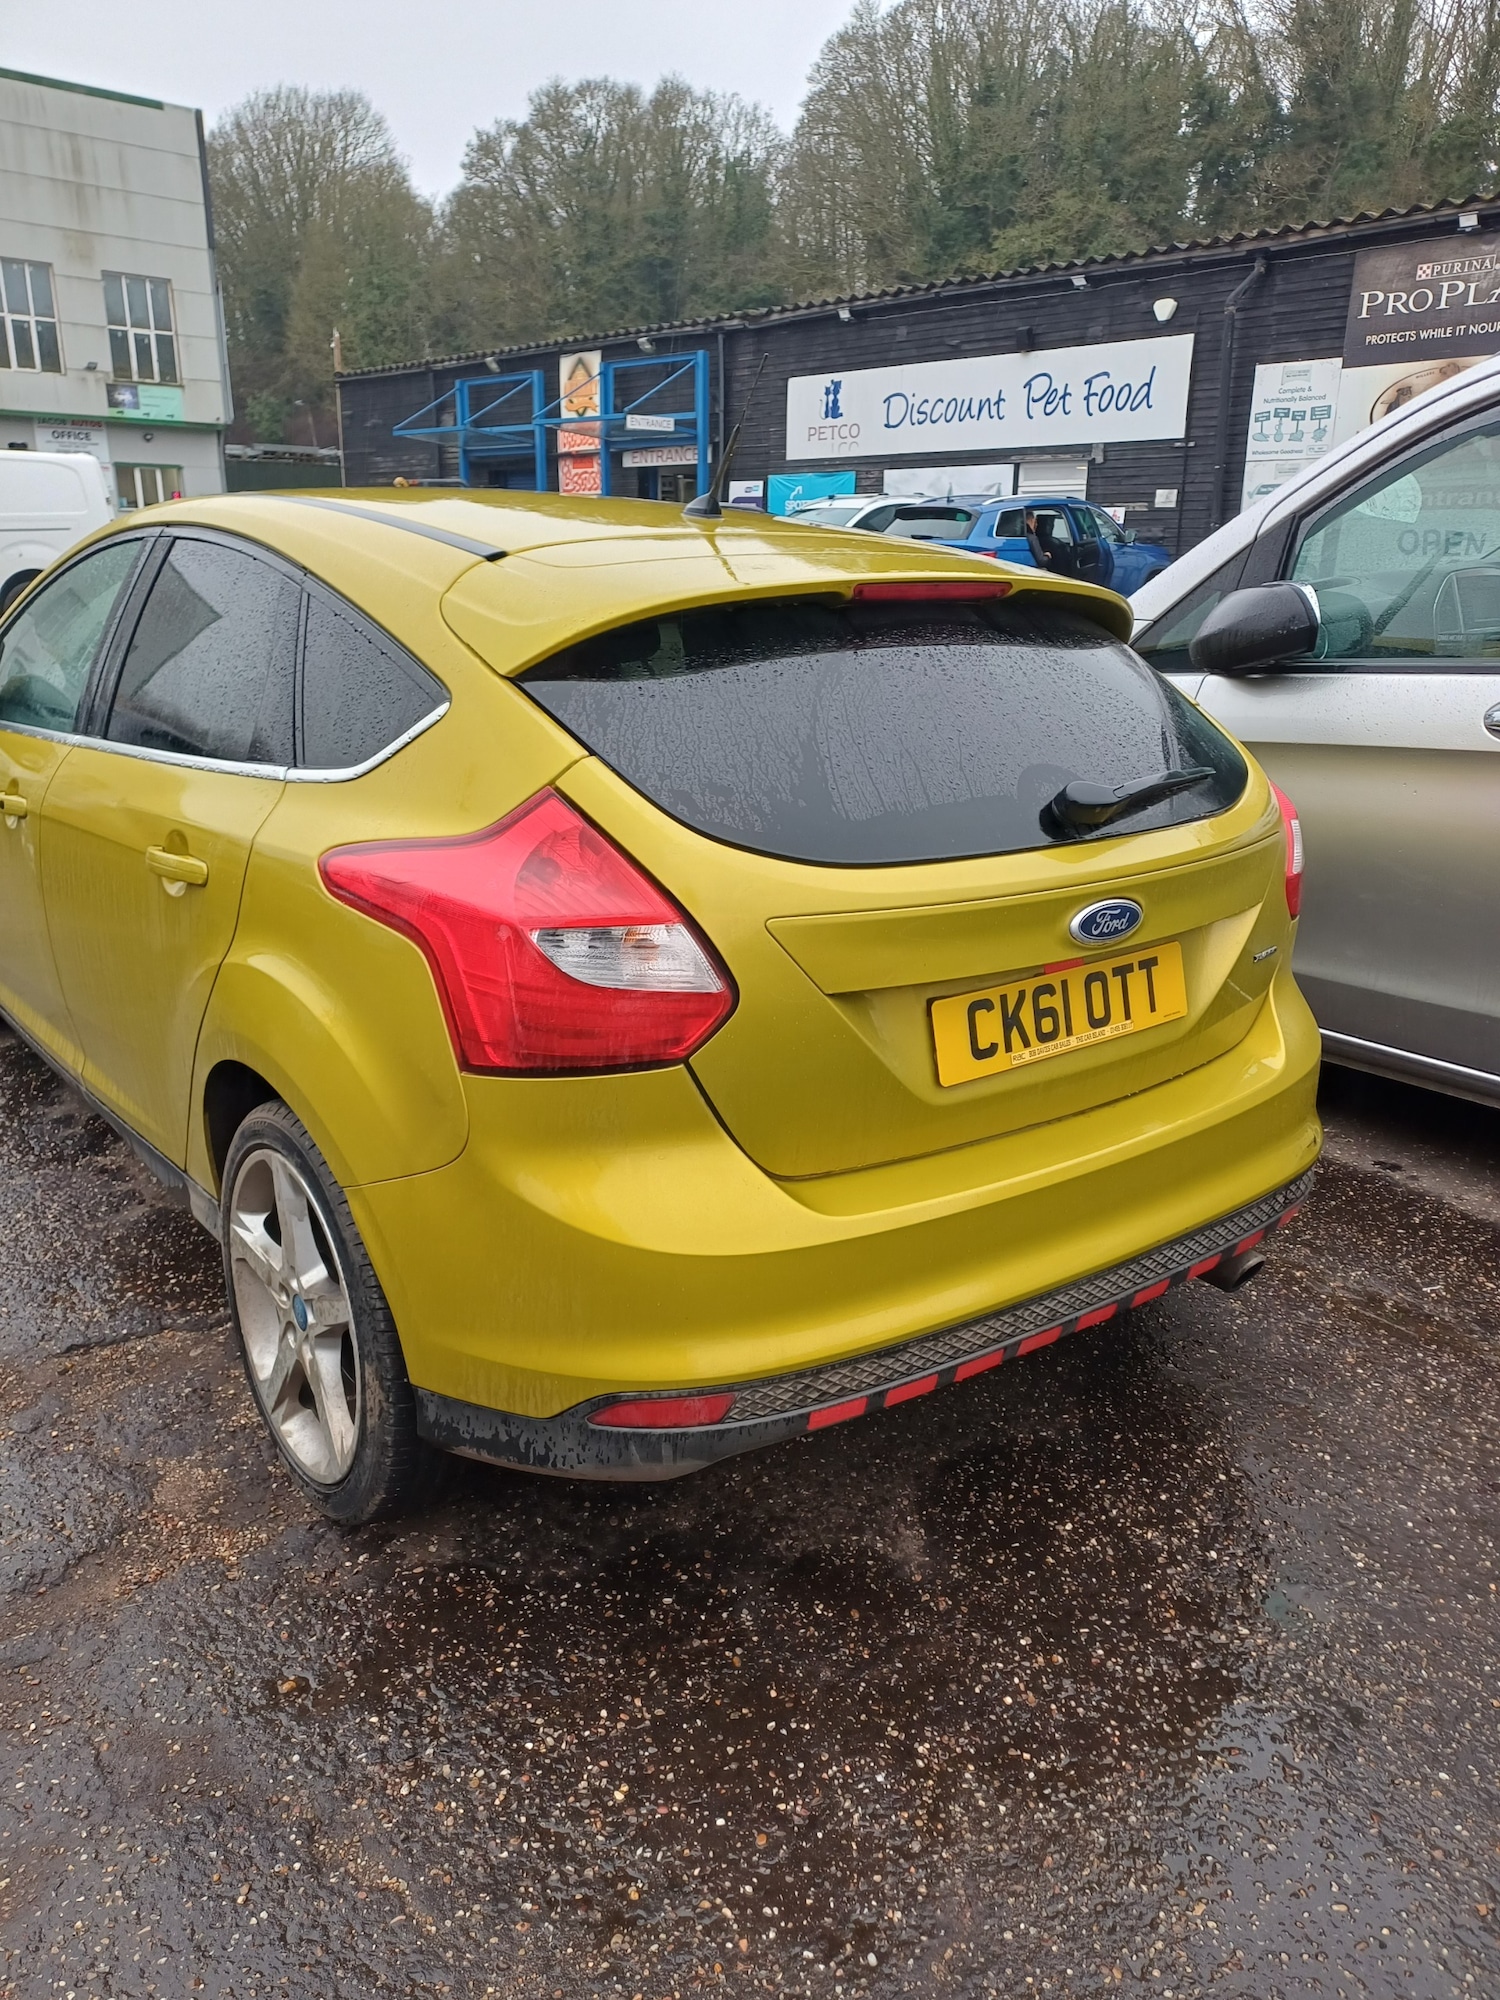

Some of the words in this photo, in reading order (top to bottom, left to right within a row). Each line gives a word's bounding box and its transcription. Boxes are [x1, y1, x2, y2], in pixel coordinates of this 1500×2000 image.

[1433, 258, 1492, 276] PURINA
[1365, 331, 1416, 345] PROTECTS
[1420, 327, 1453, 340] WHILE
[1455, 325, 1466, 336] IT
[883, 389, 1005, 429] Discount
[1023, 372, 1072, 420] Pet
[1083, 366, 1157, 417] Food
[1263, 395, 1298, 404] Nutritionally
[1298, 393, 1327, 402] Balanced
[1278, 387, 1306, 396] Complete
[629, 416, 673, 430] ENTRANCE
[51, 429, 92, 442] OFFICE
[807, 423, 861, 442] PETCO
[631, 447, 699, 464] ENTRANCE
[1398, 529, 1487, 556] OPEN
[1092, 908, 1130, 936] Ford
[967, 979, 1074, 1061] CK61
[1084, 956, 1159, 1030] OTT
